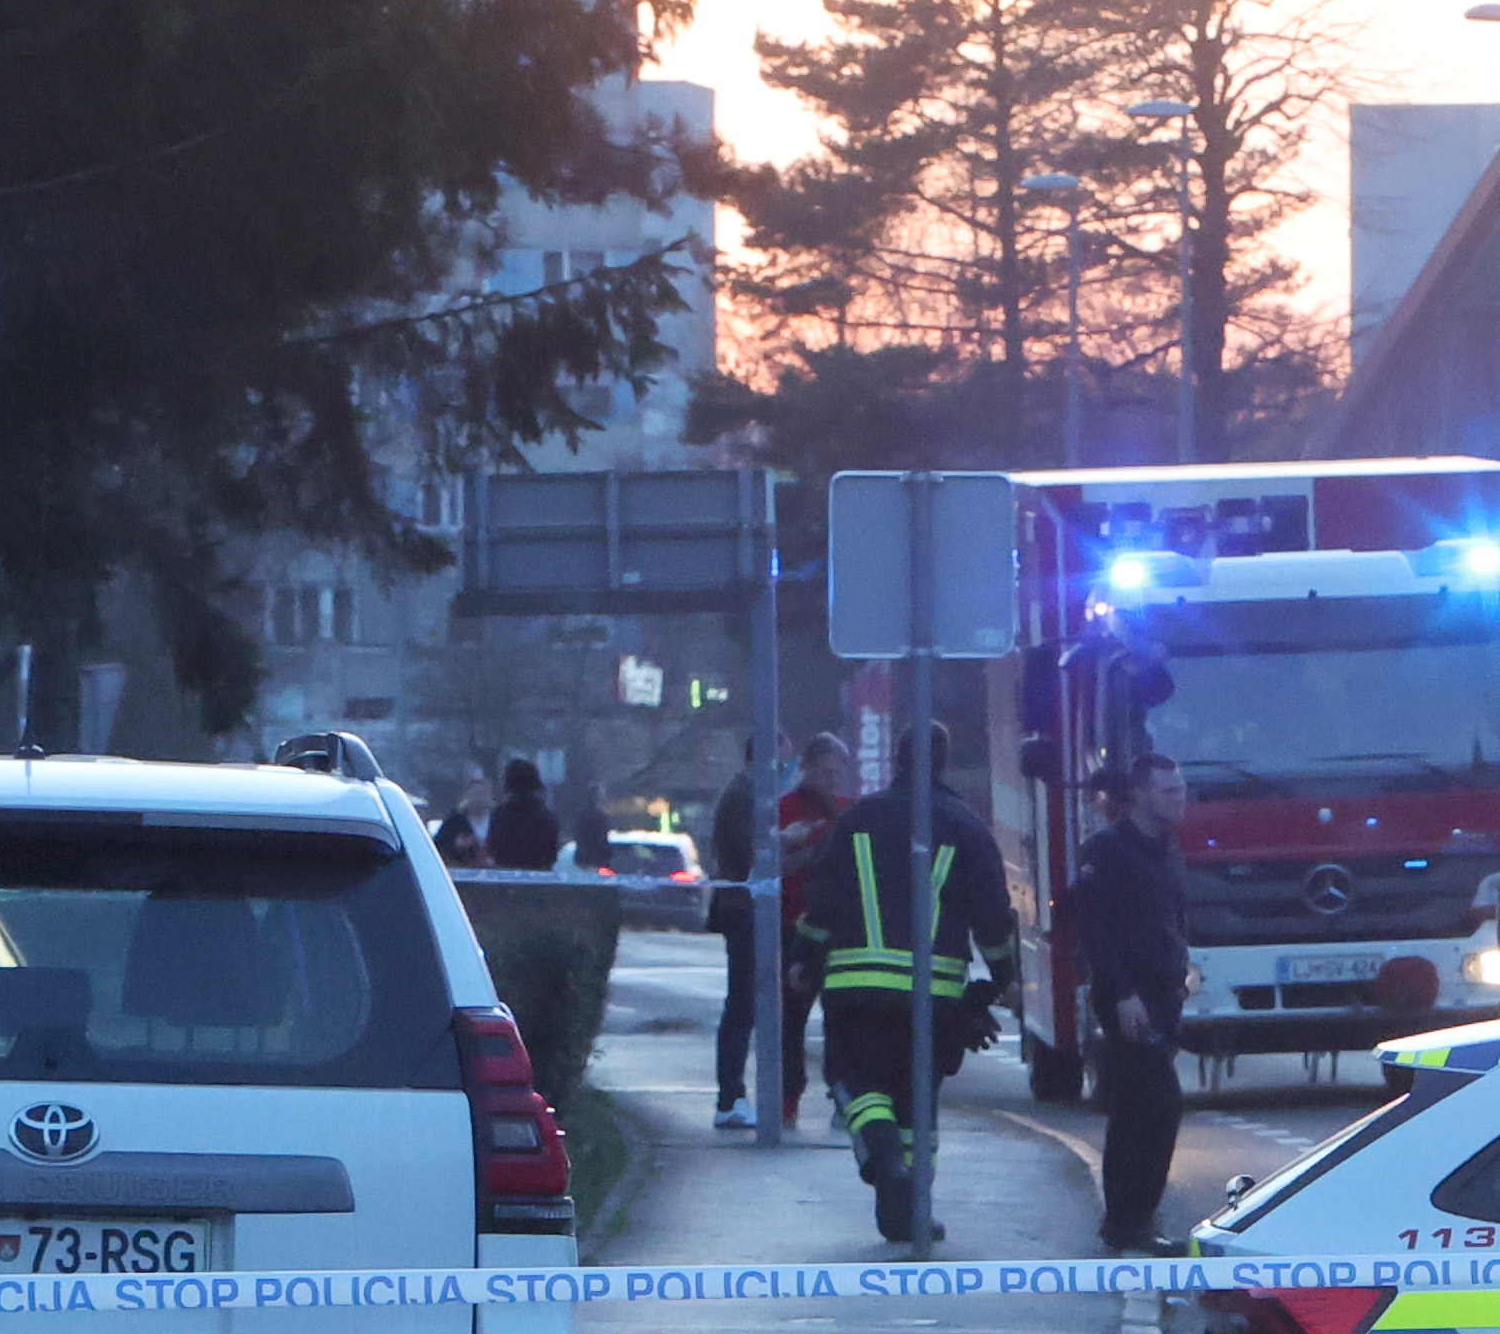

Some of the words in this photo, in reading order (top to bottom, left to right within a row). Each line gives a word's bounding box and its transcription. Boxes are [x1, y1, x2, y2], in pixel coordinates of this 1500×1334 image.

[27, 1226, 195, 1274] 73-RSG
[1398, 1226, 1496, 1250] 113
[115, 1277, 240, 1311] STOP
[255, 1274, 467, 1308] POLICIJA
[486, 1272, 611, 1304] STOP
[627, 1269, 838, 1301] POLICIJA
[859, 1267, 984, 1296] STOP
